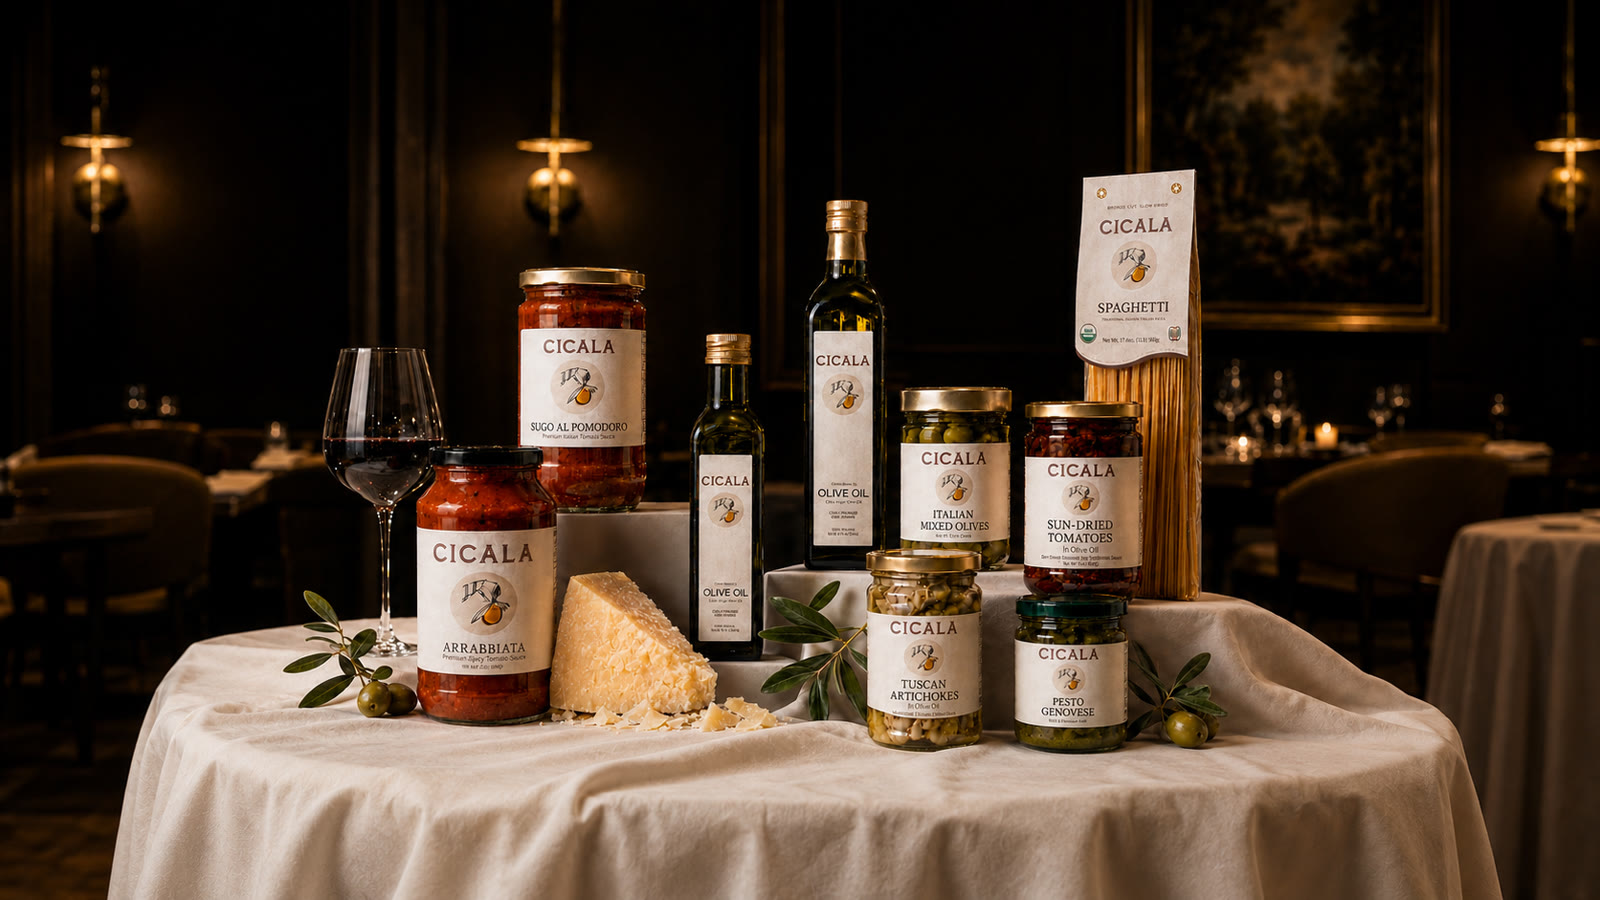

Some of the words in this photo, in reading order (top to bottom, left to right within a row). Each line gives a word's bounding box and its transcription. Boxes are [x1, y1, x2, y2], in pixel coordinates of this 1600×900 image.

[1100, 217, 1172, 235] CICALA
[1098, 301, 1169, 313] SPAGHETTI
[543, 339, 614, 354] CICALA
[816, 355, 870, 366] CICALA
[531, 422, 554, 432] SUGO
[557, 422, 569, 432] AL
[572, 422, 628, 432] POMODORO
[921, 452, 986, 465] CICALA
[1048, 464, 1115, 477] CICALA
[701, 476, 749, 486] CICALA
[818, 488, 849, 498] OLIVE
[852, 488, 869, 498] OIL
[933, 510, 974, 519] ITALIAN
[921, 521, 953, 530] MIXED
[955, 522, 989, 530] OLIVES
[1048, 520, 1113, 530] SUN-DRIED
[1048, 533, 1113, 543] TOMATOES
[433, 543, 533, 563] CICALA
[703, 588, 730, 597] OLIVE
[733, 588, 748, 597] OIL
[890, 621, 957, 634] CICALA
[443, 642, 525, 654] ARRABBIATA
[1039, 648, 1099, 660] CICALA
[901, 680, 946, 689] TUSCAN
[890, 691, 959, 701] ARTICHOKES
[1053, 698, 1084, 706] PESTO
[1041, 707, 1095, 717] GENOVESE
